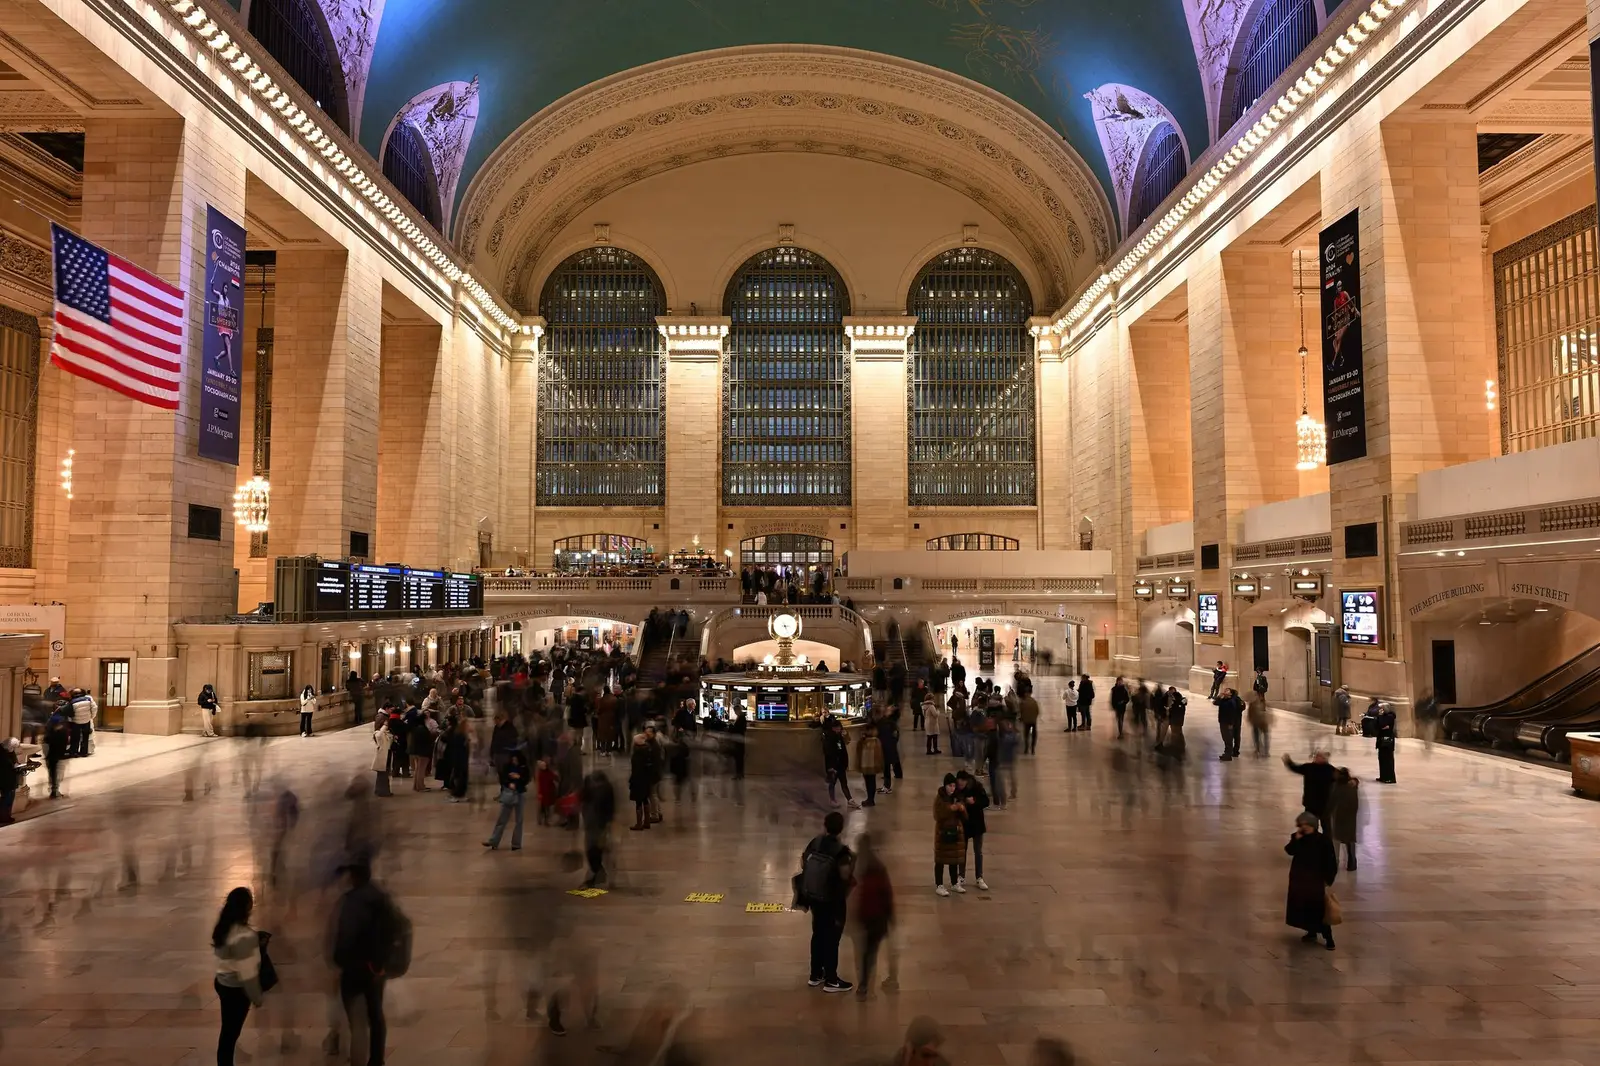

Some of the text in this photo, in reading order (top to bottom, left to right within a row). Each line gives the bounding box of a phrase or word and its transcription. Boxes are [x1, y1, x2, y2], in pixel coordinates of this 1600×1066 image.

[207, 368, 225, 380] JANUARY
[1328, 376, 1346, 386] JANUARY
[1512, 584, 1570, 602] 45TH STREET
[1408, 583, 1484, 616] THE METLIFE BUILDING
[520, 608, 553, 616] MACHINES
[948, 608, 1000, 620] TICKET MACHINES
